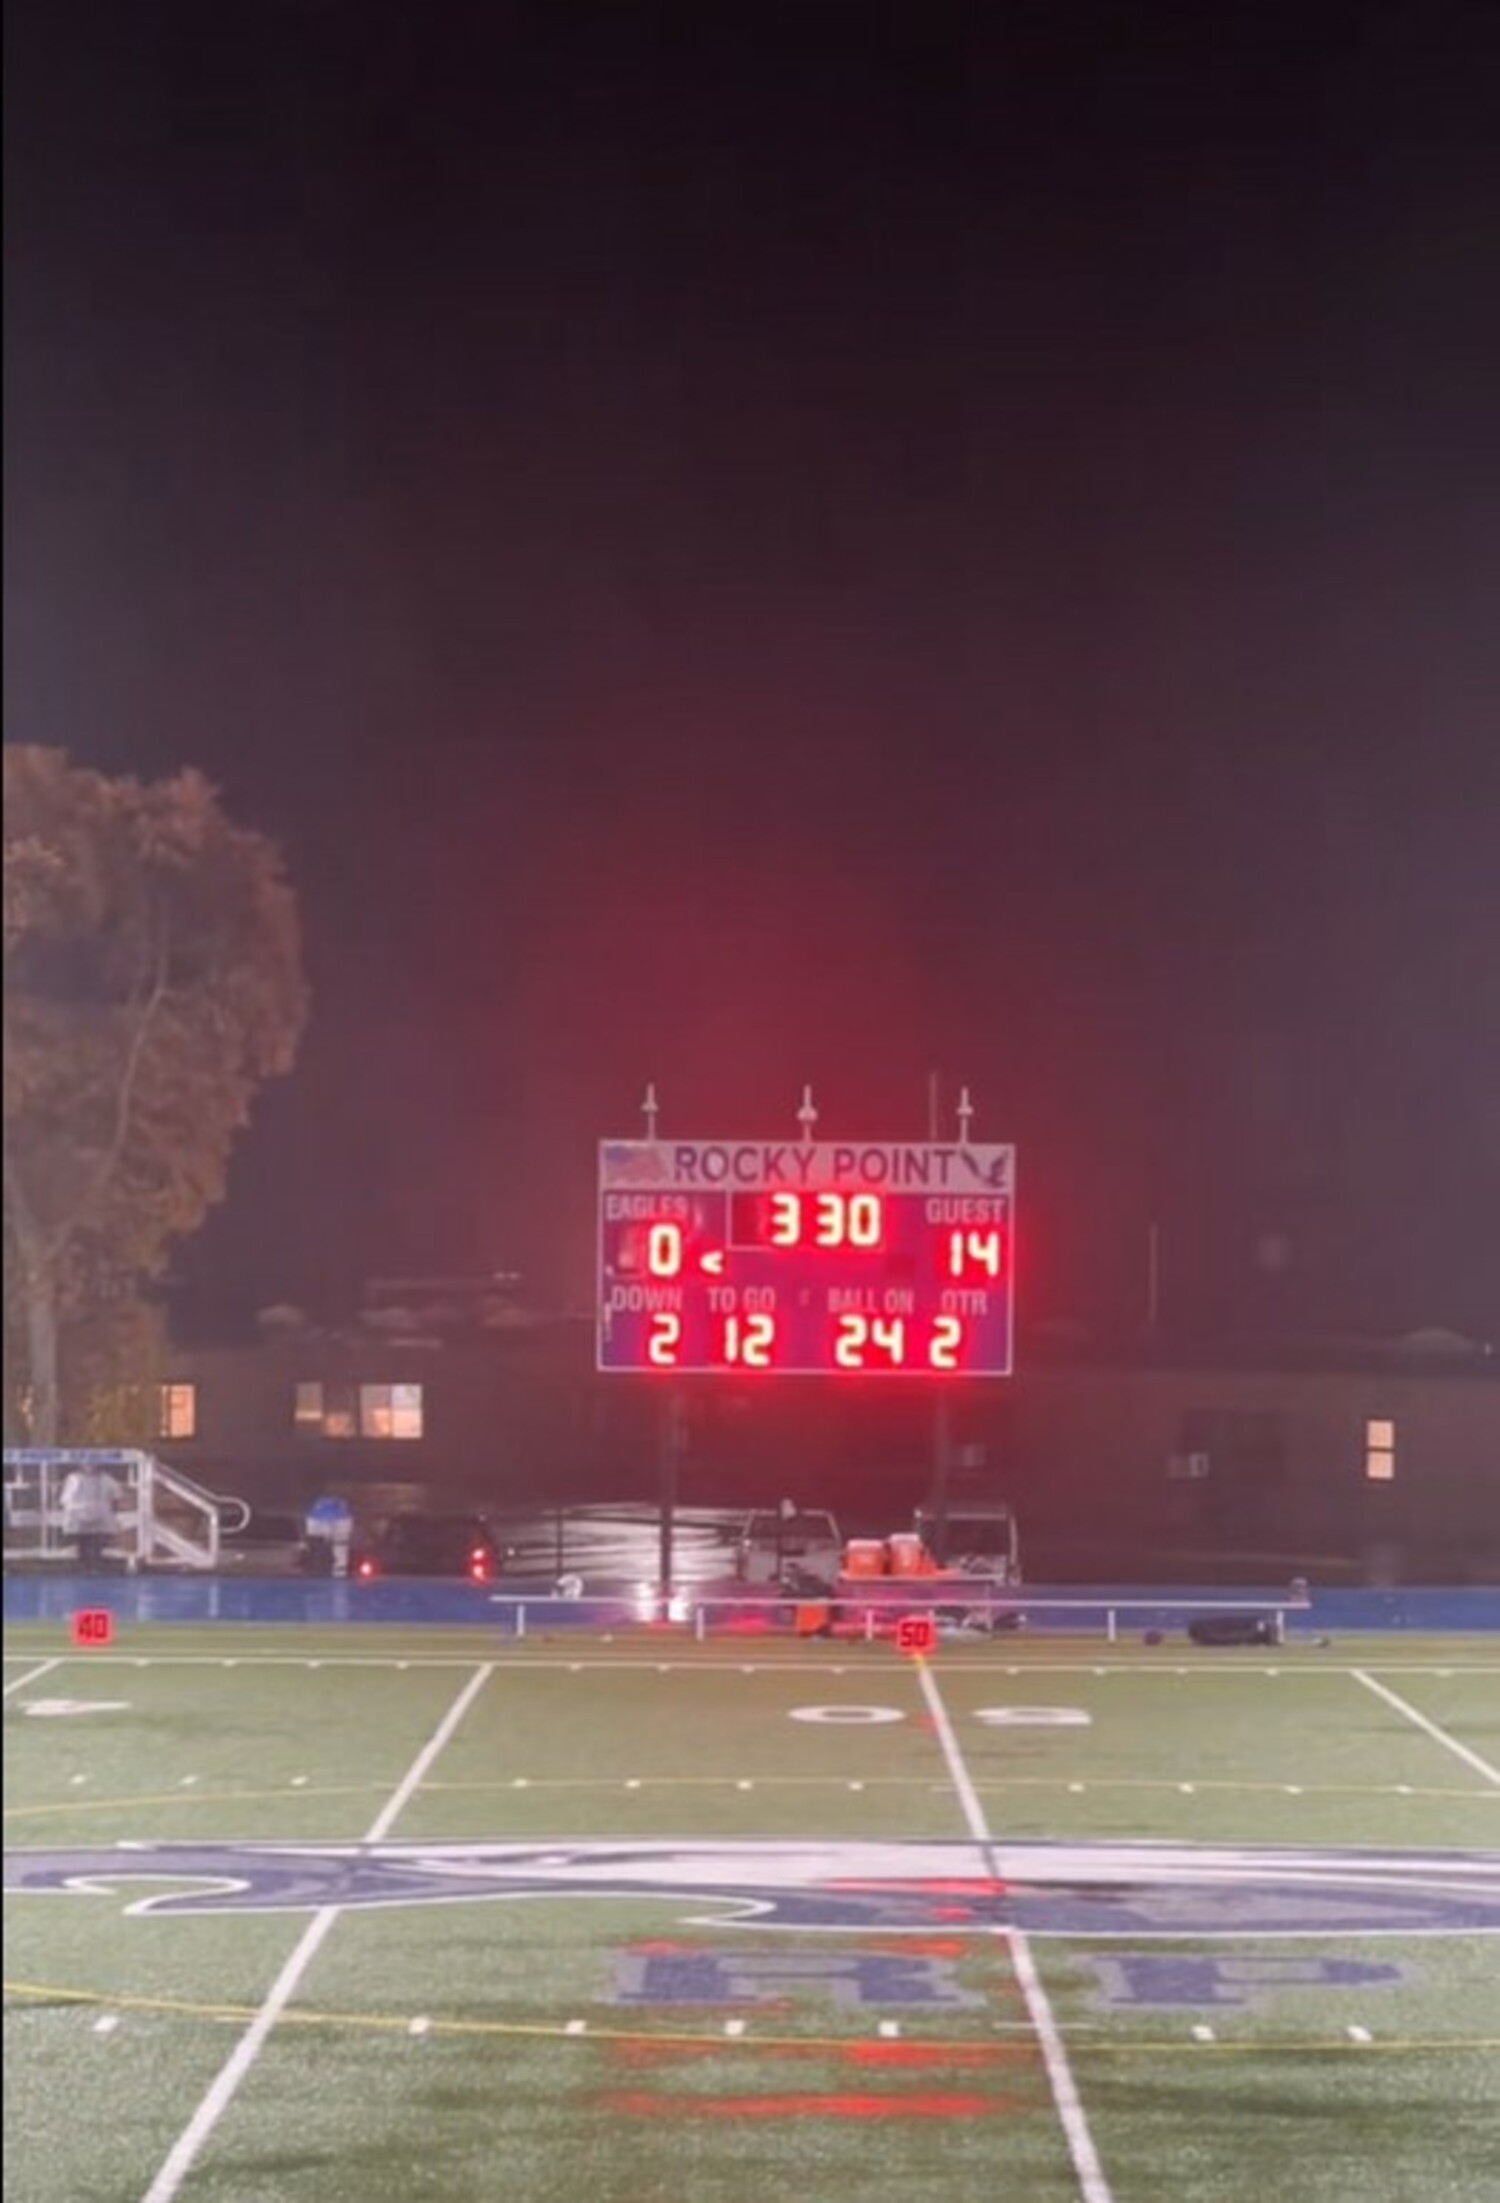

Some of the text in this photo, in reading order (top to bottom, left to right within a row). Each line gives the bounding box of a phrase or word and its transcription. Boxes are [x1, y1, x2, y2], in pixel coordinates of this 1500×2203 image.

[674, 1146, 955, 1184] ROCKY POINT
[606, 1195, 689, 1221] EAGLES
[925, 1197, 1007, 1224] GUEST
[650, 1223, 681, 1276] 0
[950, 1230, 999, 1277] 14
[611, 1284, 683, 1312] DOWN
[708, 1286, 776, 1312] TO GO
[827, 1288, 914, 1313] BALL ON
[649, 1313, 680, 1364] 2
[725, 1313, 774, 1366] 12
[835, 1314, 904, 1367] 24
[929, 1315, 961, 1368] 2
[77, 1613, 108, 1640] 40
[899, 1622, 929, 1647] 50
